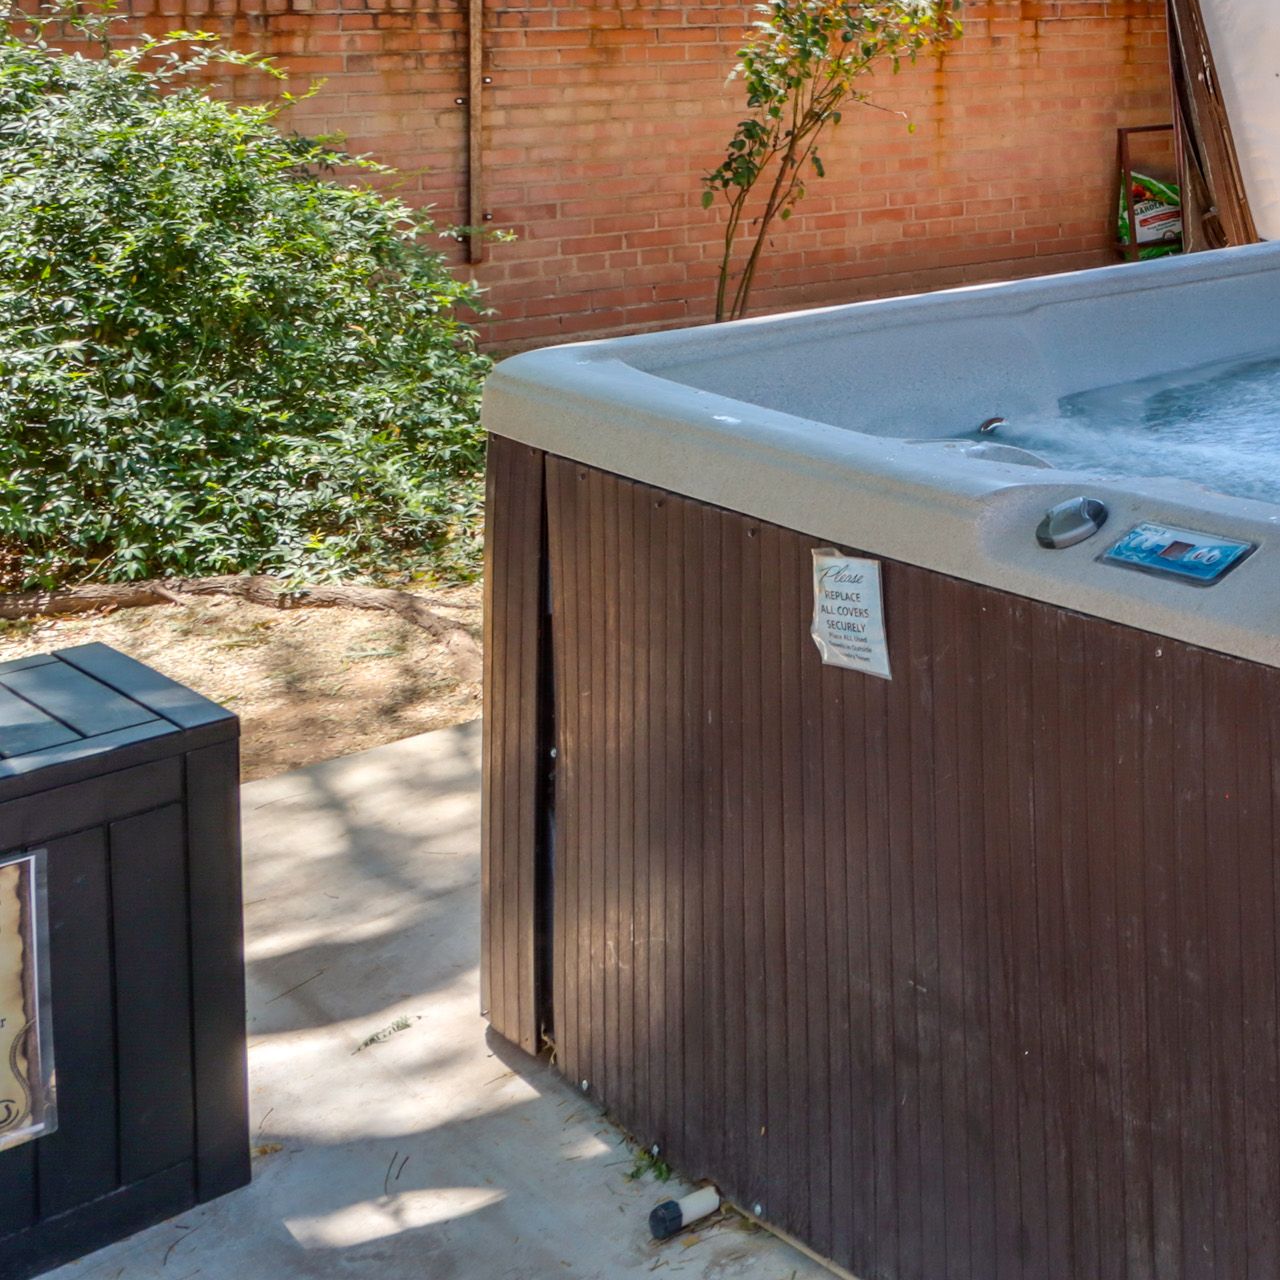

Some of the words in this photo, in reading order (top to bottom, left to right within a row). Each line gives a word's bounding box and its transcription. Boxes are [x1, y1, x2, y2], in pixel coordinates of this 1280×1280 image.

[1135, 201, 1164, 216] GARDEN
[819, 564, 864, 585] Please
[825, 590, 861, 602] REPLACE
[821, 604, 836, 615] ALL
[837, 606, 869, 618] COVERS
[826, 619, 866, 633] SECURELY
